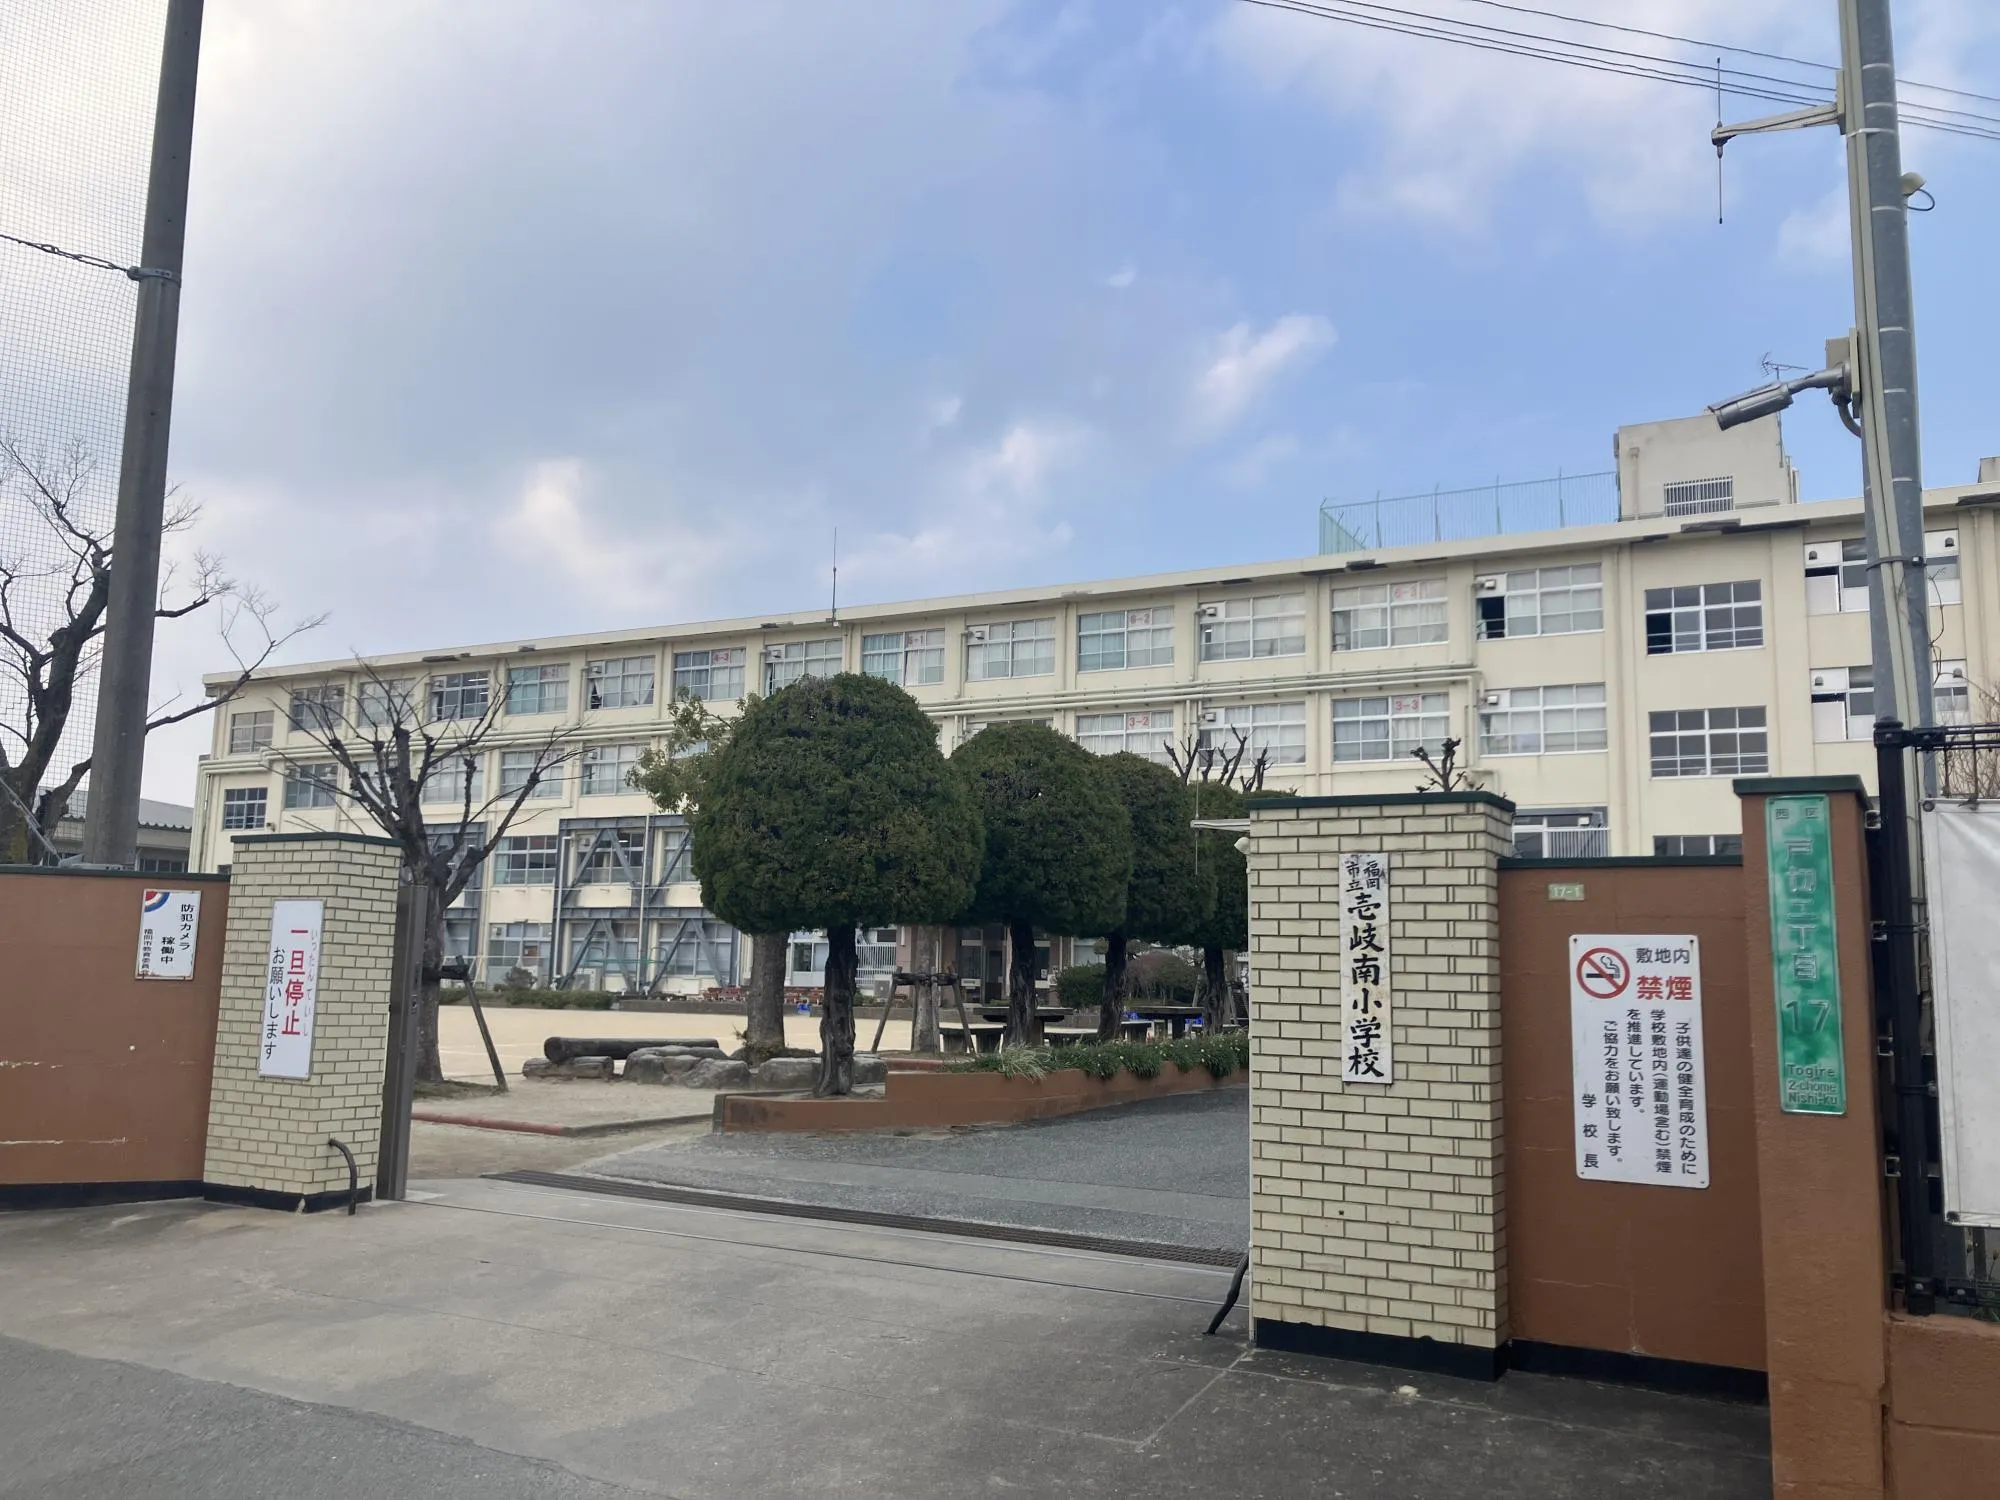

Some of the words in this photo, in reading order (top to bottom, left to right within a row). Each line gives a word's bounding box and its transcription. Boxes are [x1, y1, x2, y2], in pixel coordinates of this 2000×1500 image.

[1395, 700, 1419, 711] 3-3
[1129, 716, 1149, 727] 3-2
[1345, 861, 1364, 892] 市立
[1362, 860, 1380, 890] 福岡
[1554, 886, 1580, 898] 17-1
[179, 903, 195, 951] 防犯カメラ
[160, 936, 176, 965] 稼働中
[1635, 947, 1691, 965] 敷地内
[281, 929, 309, 1036] 一旦停止
[302, 928, 318, 1037] いったんていし
[1347, 892, 1385, 1078] 壱岐南小学校
[1636, 975, 1693, 1001] 禁煙
[264, 946, 285, 1060] お願いします
[1786, 1000, 1832, 1033] 17
[1626, 1008, 1645, 1114] を推進しています。
[1787, 1063, 1836, 1079] Togire
[1602, 1020, 1623, 1163] ご協力をお願い致します。
[1675, 1022, 1698, 1175] 子供達の健全育成のために
[1788, 1079, 1837, 1093] 2-chome
[1788, 1091, 1838, 1105] Nishi-ku
